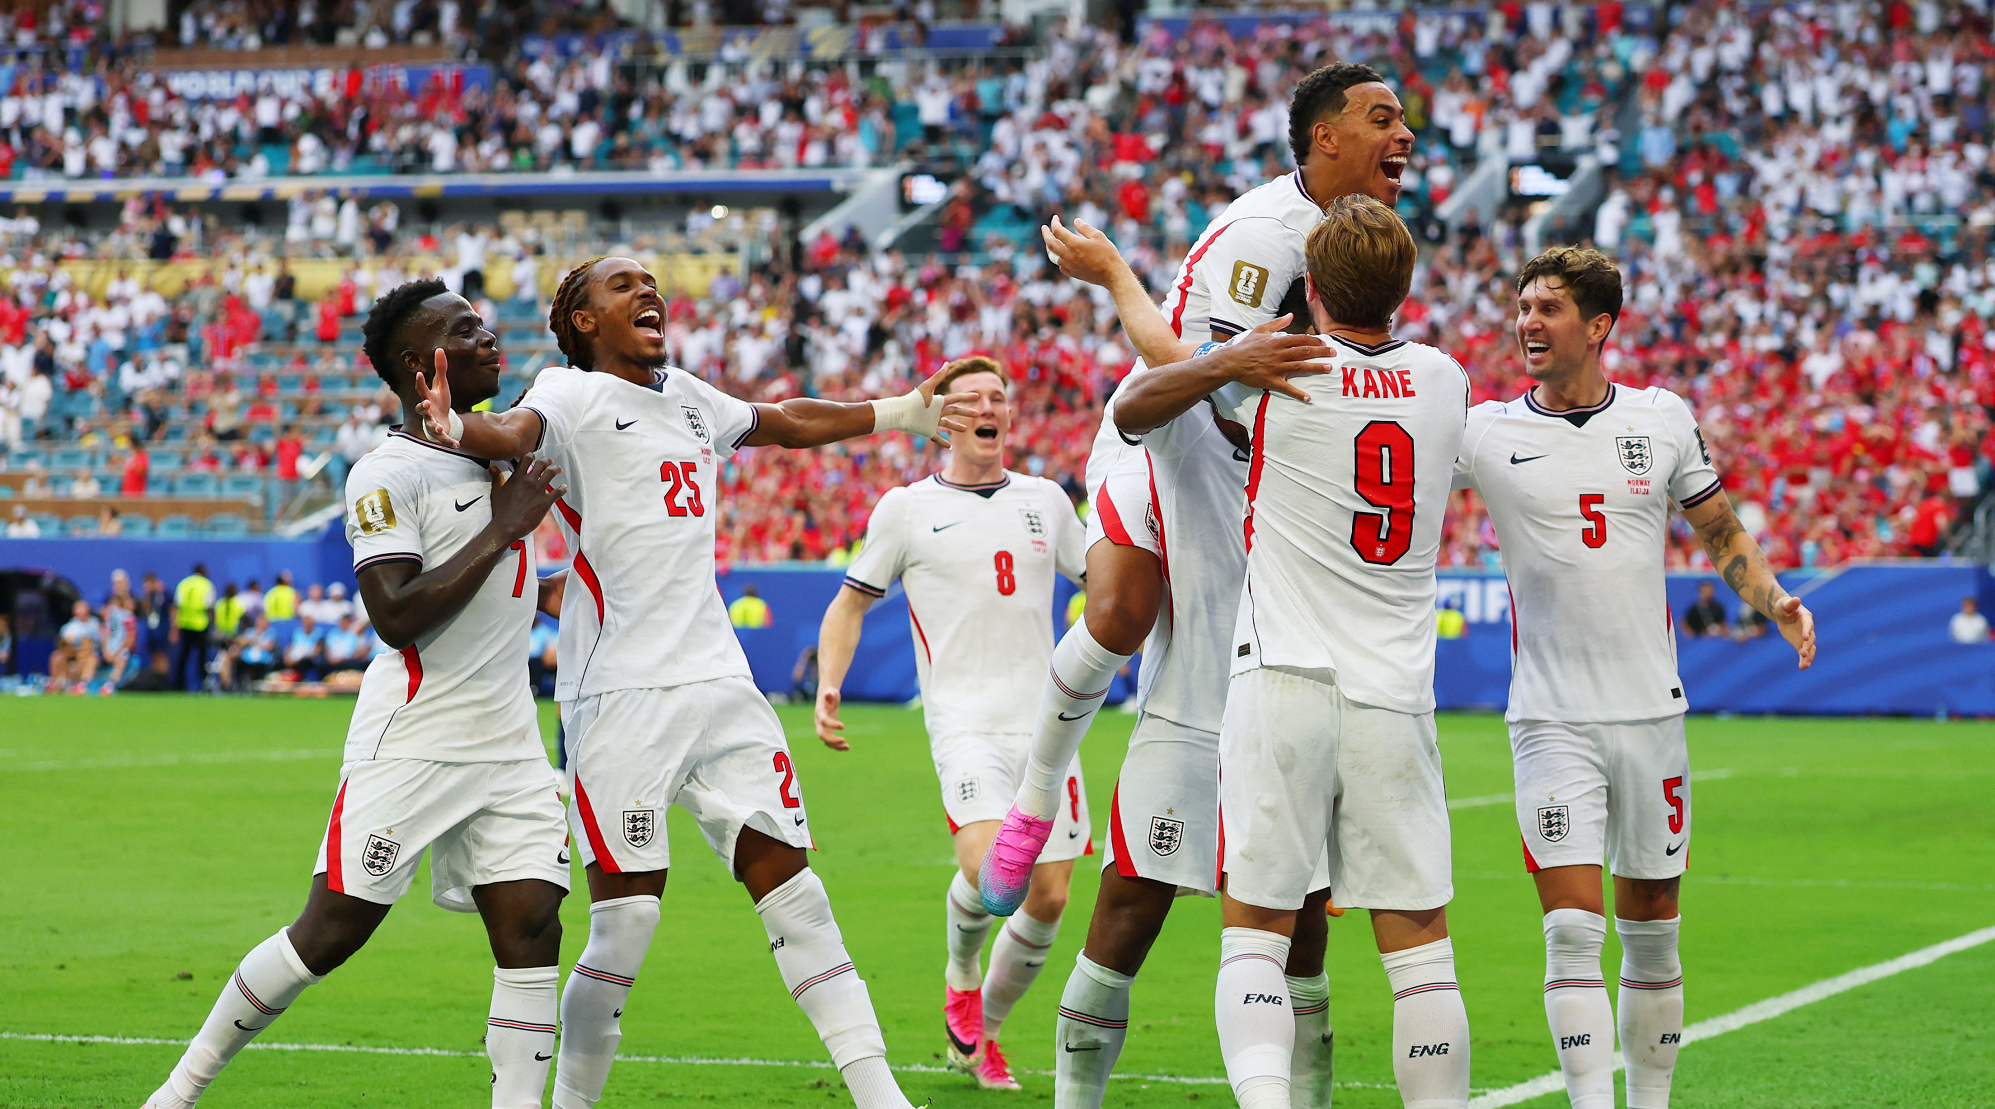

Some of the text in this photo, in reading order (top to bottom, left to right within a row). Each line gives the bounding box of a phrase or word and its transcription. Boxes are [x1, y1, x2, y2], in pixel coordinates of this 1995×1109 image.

[1341, 366, 1416, 399] KANE
[659, 460, 705, 518] 25
[1350, 420, 1416, 566] 9
[1627, 479, 1651, 487] NORWAY
[1579, 493, 1607, 549] 5
[510, 539, 528, 599] 7
[994, 550, 1017, 596] 8
[1067, 775, 1079, 824] 8
[1662, 775, 1684, 835] 5
[1243, 993, 1283, 1006] ENG
[1408, 1042, 1450, 1058] ENG
[1560, 1033, 1591, 1051] ENG
[1660, 1032, 1681, 1044] EN
